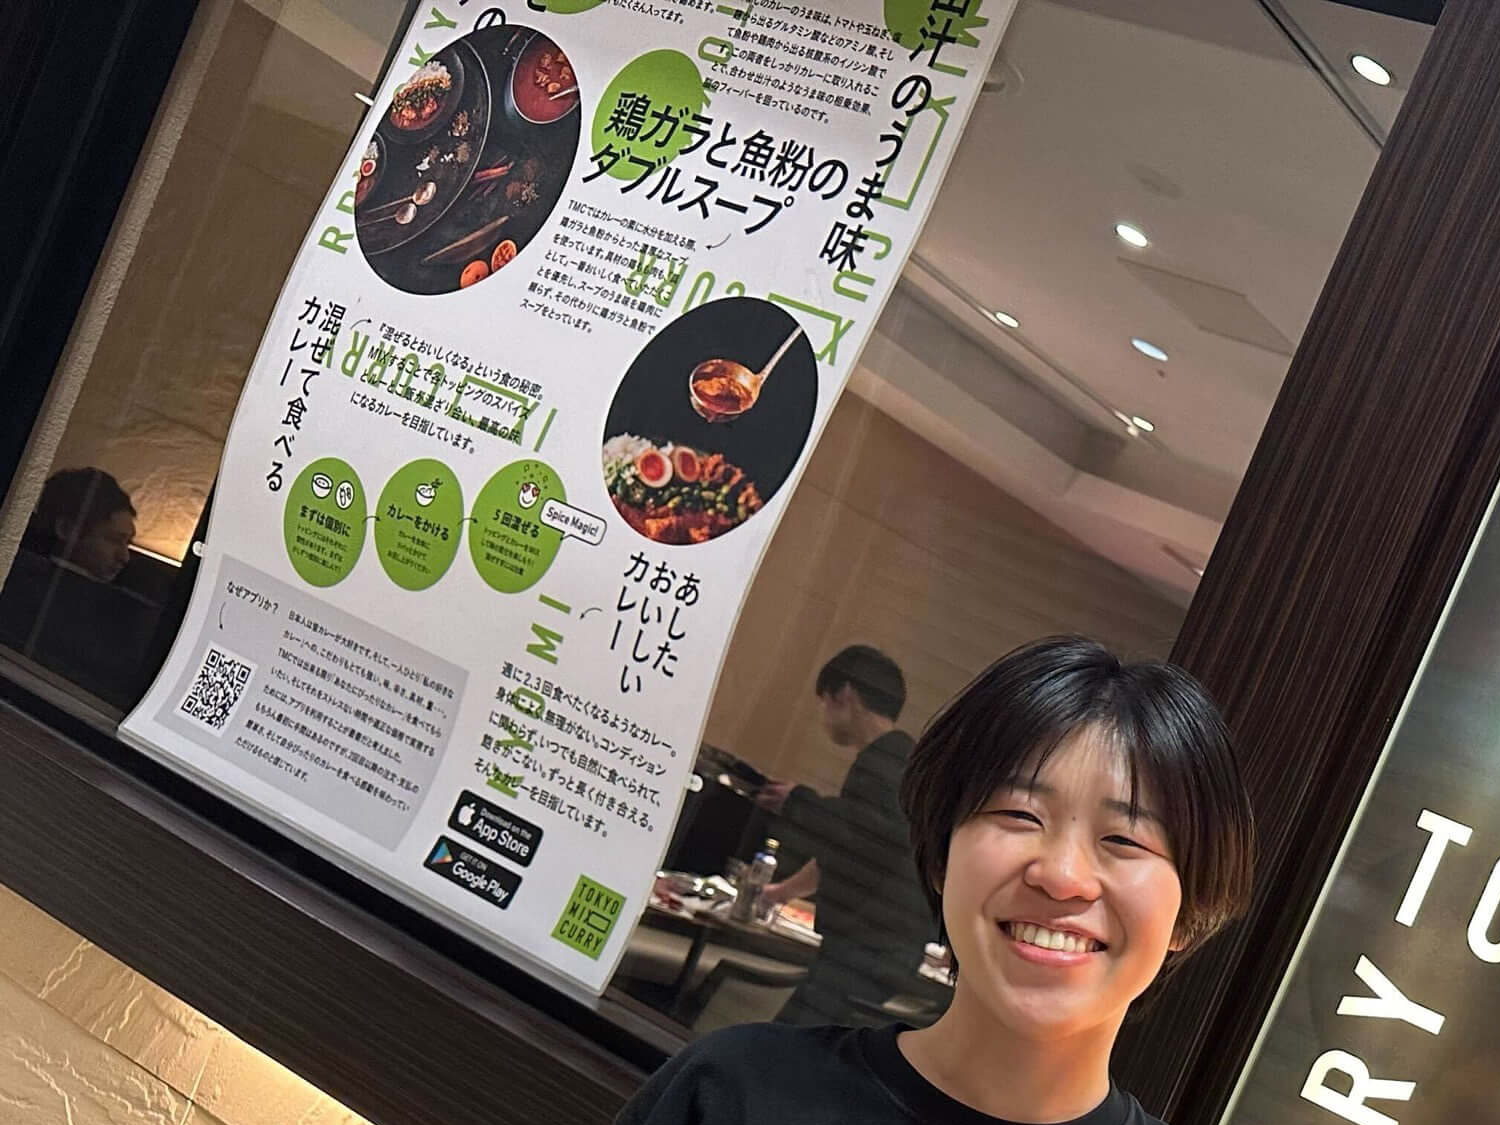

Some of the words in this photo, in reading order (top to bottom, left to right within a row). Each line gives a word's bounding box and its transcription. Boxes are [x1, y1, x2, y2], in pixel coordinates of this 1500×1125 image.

[582, 142, 794, 236] ダブルスープ
[604, 91, 849, 201] 鶏ガラと魚粉の
[279, 296, 322, 387] カレー
[266, 301, 347, 491] 混ぜて食べる
[546, 506, 569, 528] Spice
[610, 551, 650, 650] カレー
[620, 561, 677, 693] おいしい
[652, 572, 701, 678] あした
[452, 861, 487, 891] Google
[486, 879, 510, 903] Play
[473, 818, 498, 842] App
[499, 828, 530, 857] Store
[559, 919, 604, 952] CURRY
[580, 883, 621, 916] TOKYO
